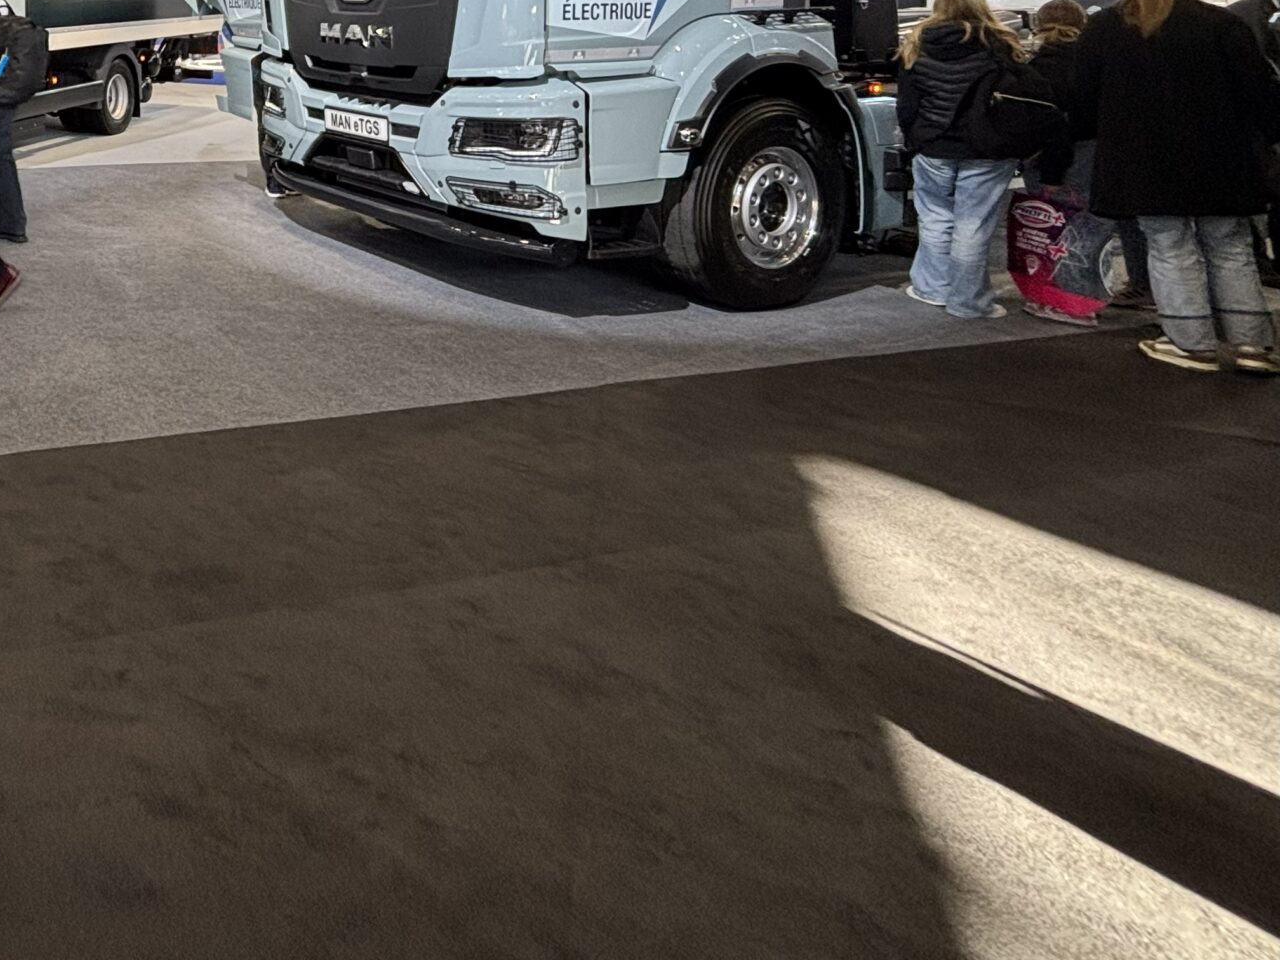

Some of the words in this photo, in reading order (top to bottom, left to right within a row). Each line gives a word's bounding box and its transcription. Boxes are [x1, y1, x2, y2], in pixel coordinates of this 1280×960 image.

[320, 22, 393, 49] MAN
[331, 113, 351, 130] MAN
[354, 118, 380, 136] eTGS
